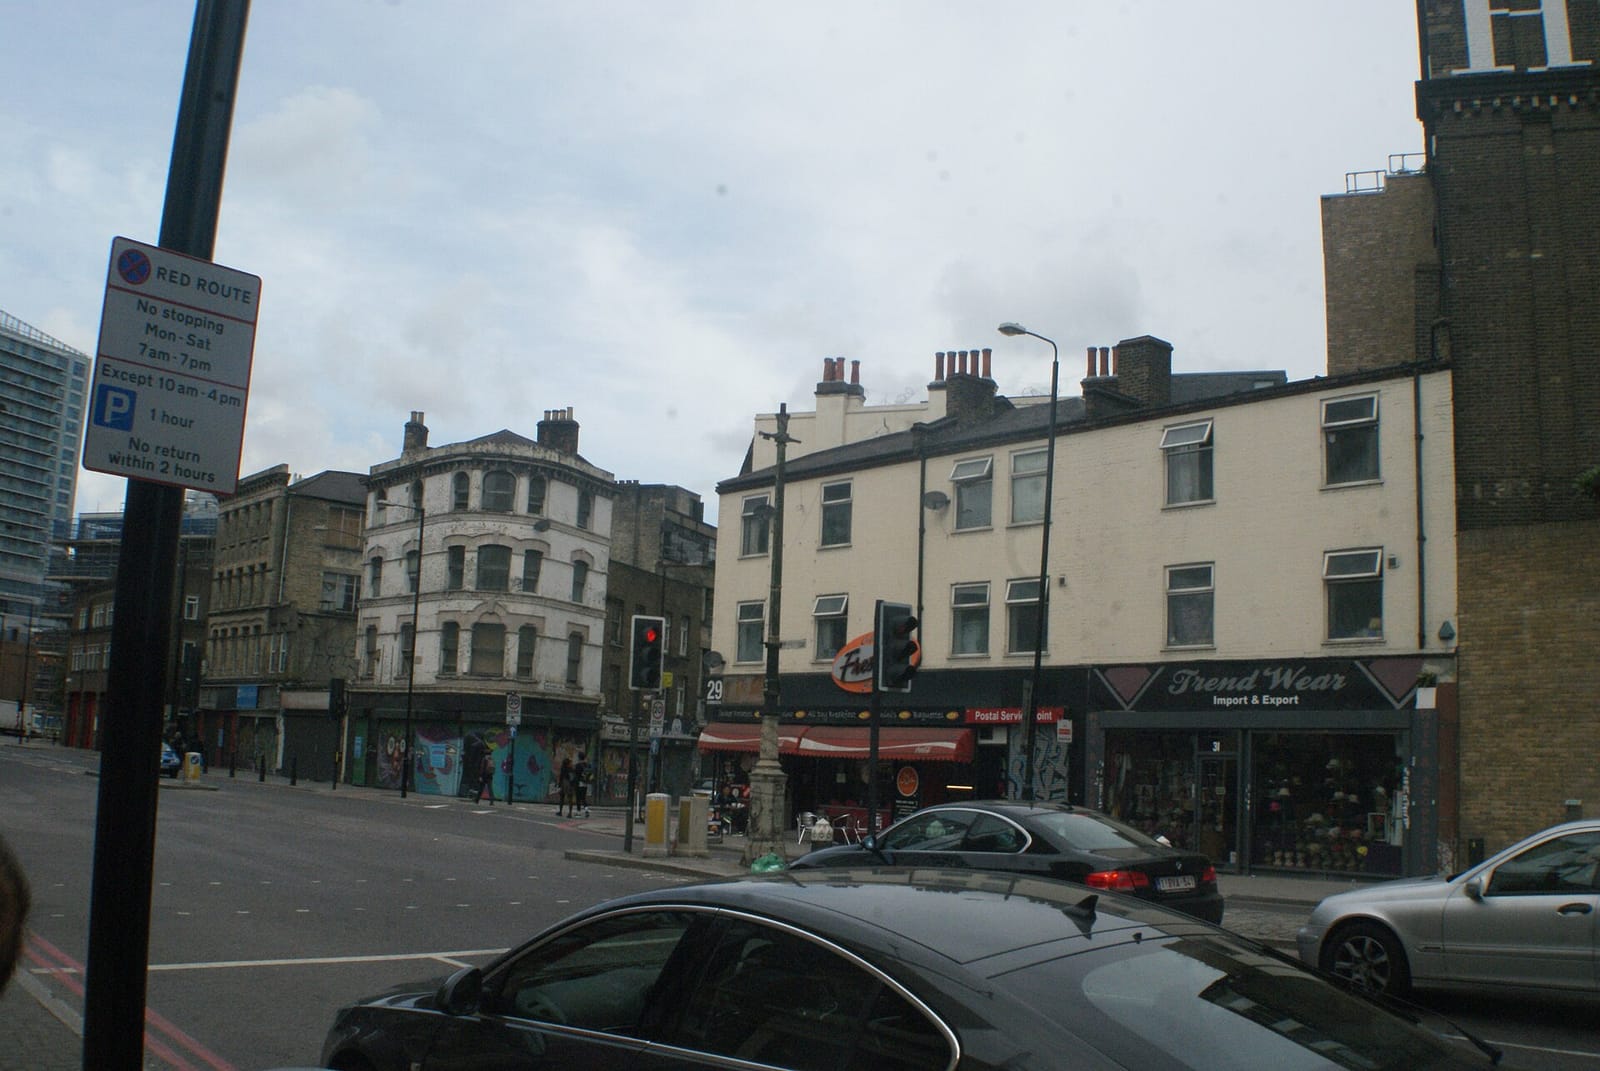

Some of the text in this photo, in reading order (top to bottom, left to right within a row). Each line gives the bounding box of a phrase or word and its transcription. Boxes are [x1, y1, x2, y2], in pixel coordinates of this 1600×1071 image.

[156, 266, 252, 305] RED ROUTE
[136, 299, 224, 335] No stopping
[101, 364, 153, 388] Except
[103, 391, 131, 423] P
[149, 408, 195, 429] 1 hour
[128, 436, 201, 464] No return
[108, 452, 216, 483] within 2 hours
[707, 680, 722, 699] 29
[1168, 666, 1347, 695] Trend Wear
[1213, 695, 1299, 706] Import & Export
[975, 711, 999, 720] Postal
